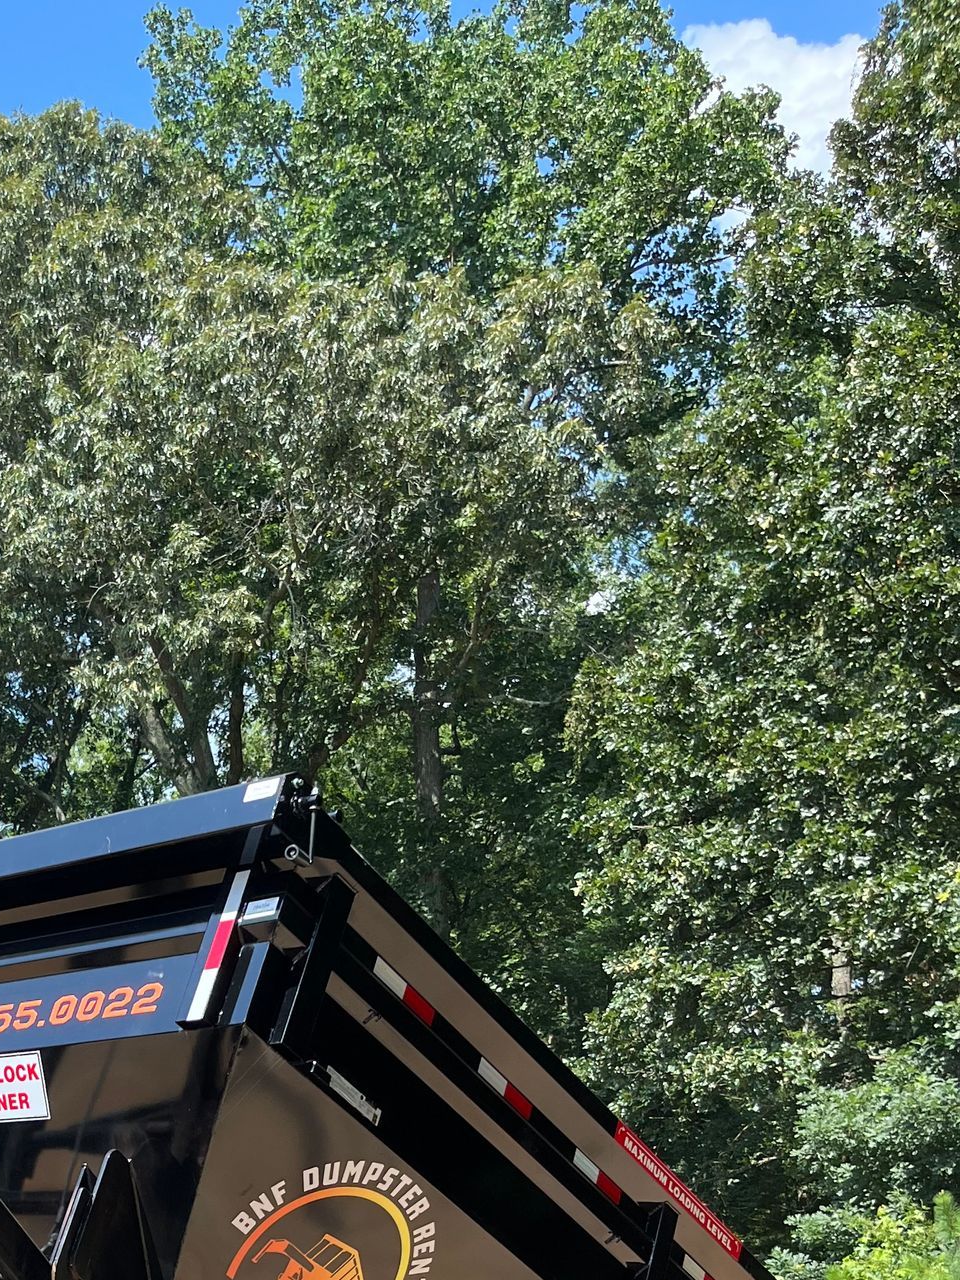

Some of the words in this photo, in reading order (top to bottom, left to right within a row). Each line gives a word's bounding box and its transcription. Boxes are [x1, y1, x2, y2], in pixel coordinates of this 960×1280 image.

[231, 1179, 287, 1235] BNF
[302, 1160, 431, 1221] DUMPSTER
[623, 1136, 669, 1187] MAXIMUM
[668, 1180, 706, 1223] LOADING
[706, 1219, 732, 1252] LEVEL
